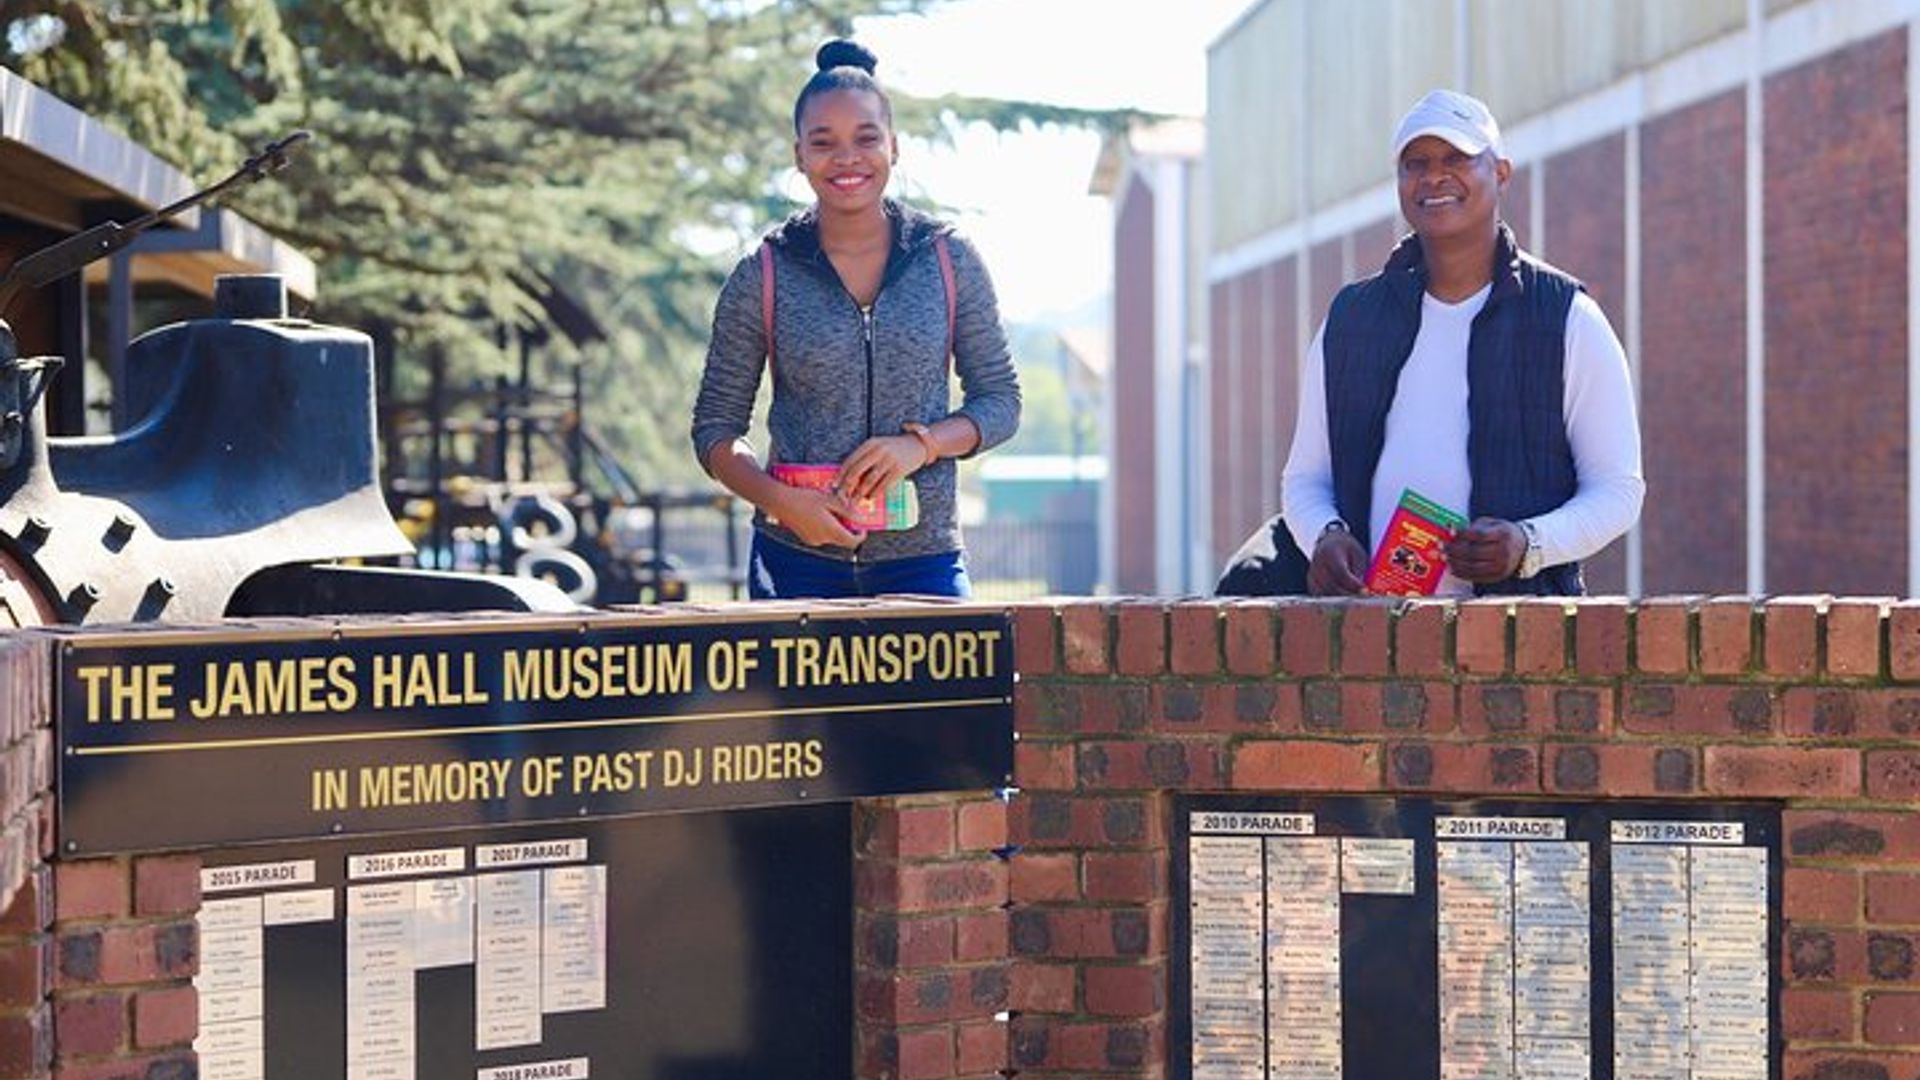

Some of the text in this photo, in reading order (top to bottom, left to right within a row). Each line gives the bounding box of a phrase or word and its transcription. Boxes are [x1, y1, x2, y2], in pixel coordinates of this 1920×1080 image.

[78, 630, 1000, 723] THE JAMES HALL MUSEUM OF TRANSPORT
[312, 739, 824, 811] IN MEMORY OF PAST DJ RIDERS
[1203, 816, 1303, 831] 2010 PARADE
[1449, 822, 1553, 836] 2011 PARADE
[1625, 825, 1732, 840] 2012 PARADE
[365, 853, 449, 873] 2016 PARADE
[491, 844, 571, 863] 2017 PARADE
[210, 866, 298, 886] 2015 PARADE
[493, 1064, 571, 1080] 2018 PARADE
